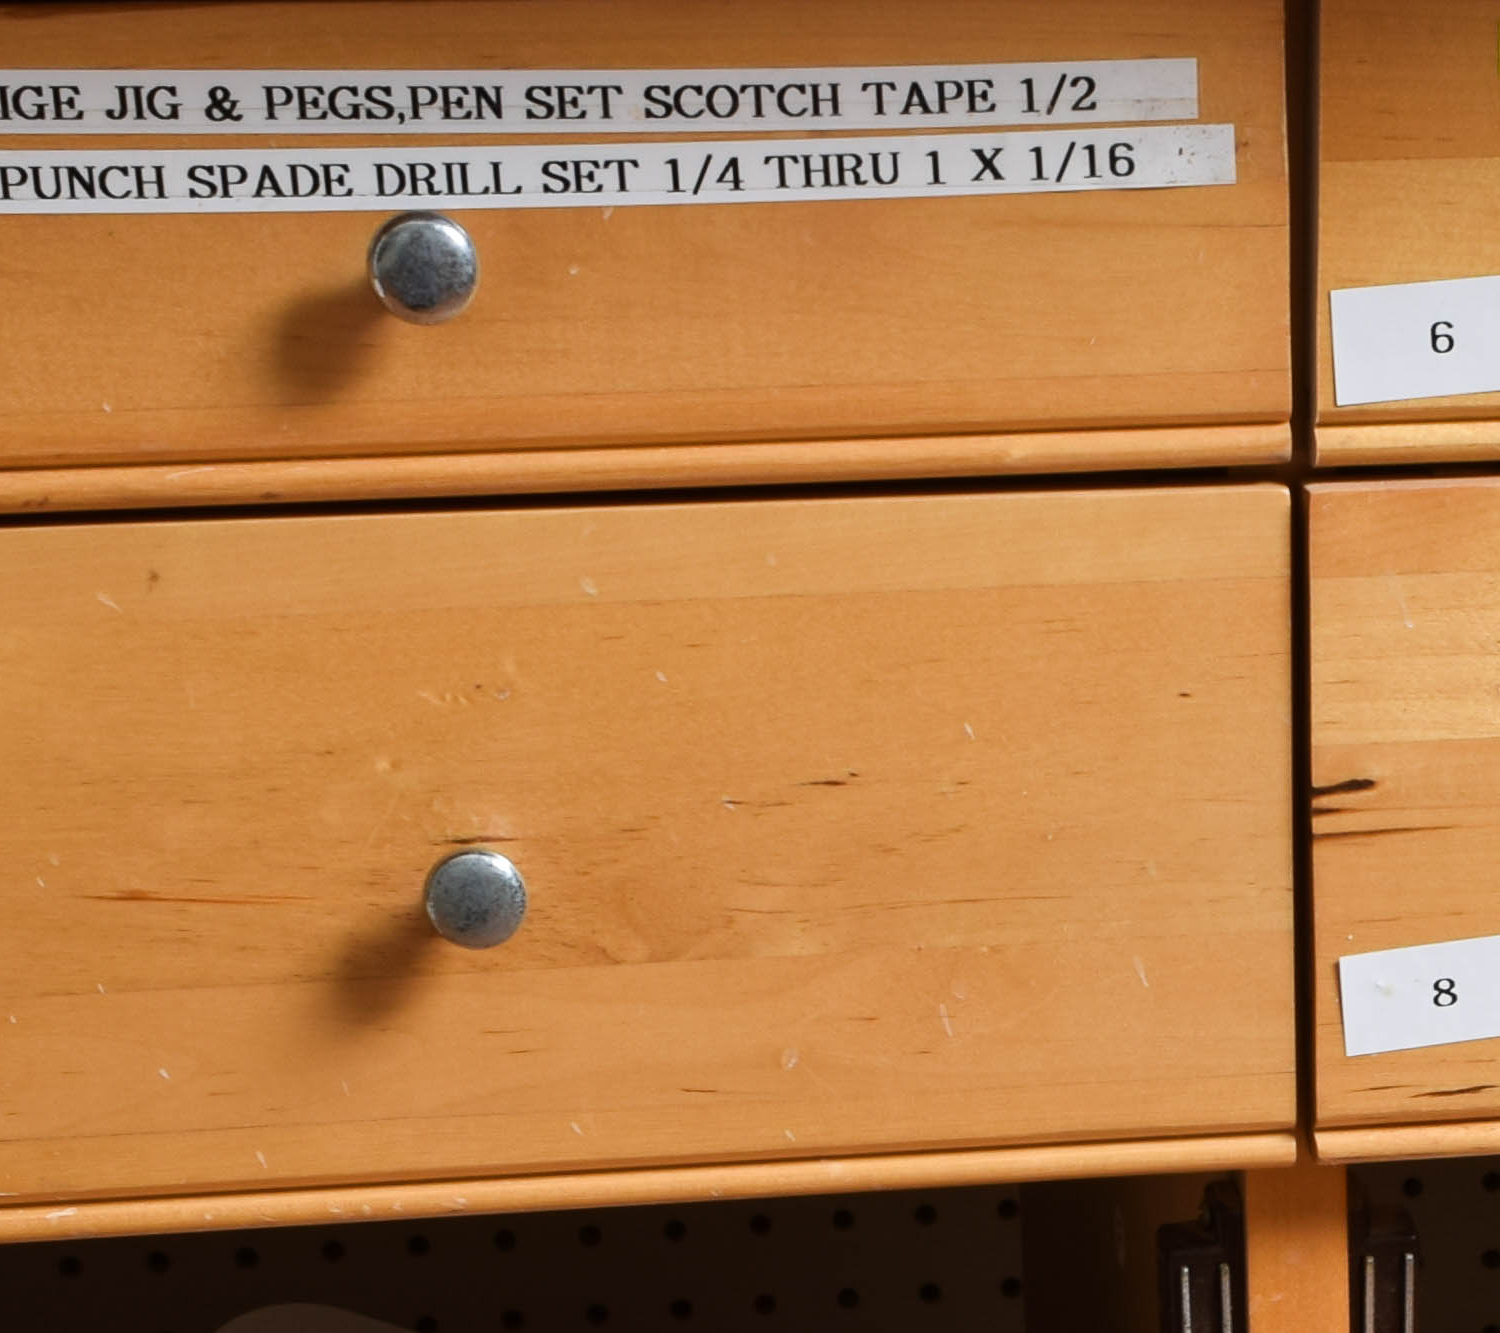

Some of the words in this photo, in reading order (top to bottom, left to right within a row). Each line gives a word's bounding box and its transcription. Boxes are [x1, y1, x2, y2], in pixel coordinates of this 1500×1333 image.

[105, 86, 182, 120] JIG
[204, 86, 243, 121] &
[262, 86, 503, 122] PEGS,PEN
[525, 85, 623, 119] SET
[644, 83, 840, 118] SCOTCH
[862, 80, 996, 114] TAPE
[1020, 74, 1096, 111] 1/2
[187, 164, 353, 198] SPADE
[374, 162, 522, 196] DRILL
[542, 160, 639, 193] SET
[665, 154, 744, 192] 1/4
[764, 152, 899, 188] THRU
[927, 151, 945, 184] 1
[972, 148, 1004, 181] X
[1030, 142, 1134, 182] 1/16
[1430, 321, 1454, 354] 6
[1433, 978, 1458, 1007] 8
